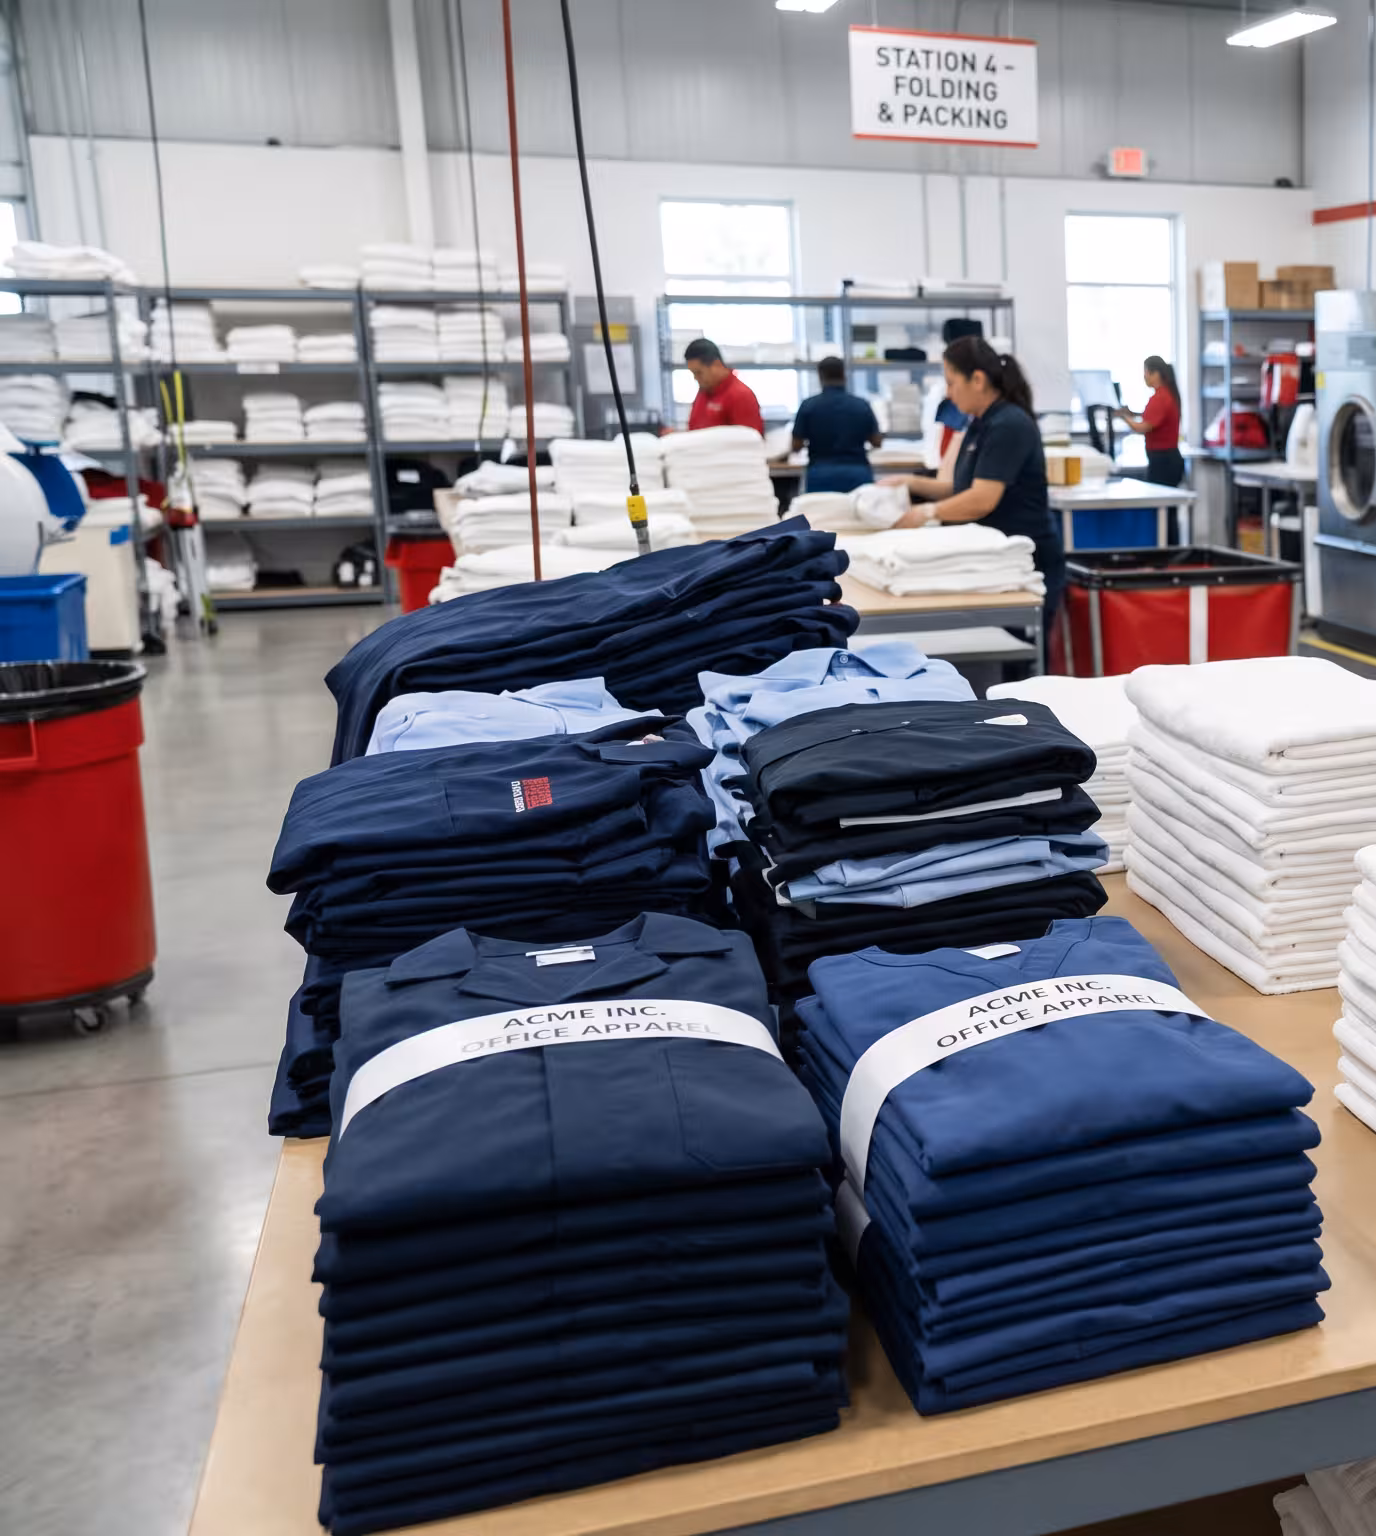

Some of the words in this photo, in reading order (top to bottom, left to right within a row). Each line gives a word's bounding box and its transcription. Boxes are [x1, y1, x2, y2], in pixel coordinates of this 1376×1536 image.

[876, 47, 977, 73] STATION
[984, 55, 997, 74] 4
[894, 75, 998, 102] FOLDING
[878, 102, 893, 122] &
[903, 103, 1008, 130] PACKING
[968, 987, 1048, 1018] ACME
[1055, 980, 1111, 994] INC.
[503, 1009, 595, 1029] ACME
[607, 1006, 666, 1017] INC.
[936, 1008, 1034, 1048] OFFICE
[1042, 994, 1165, 1015] APPAREL
[462, 1027, 570, 1054] OFFICE
[581, 1022, 721, 1036] APPAREL
